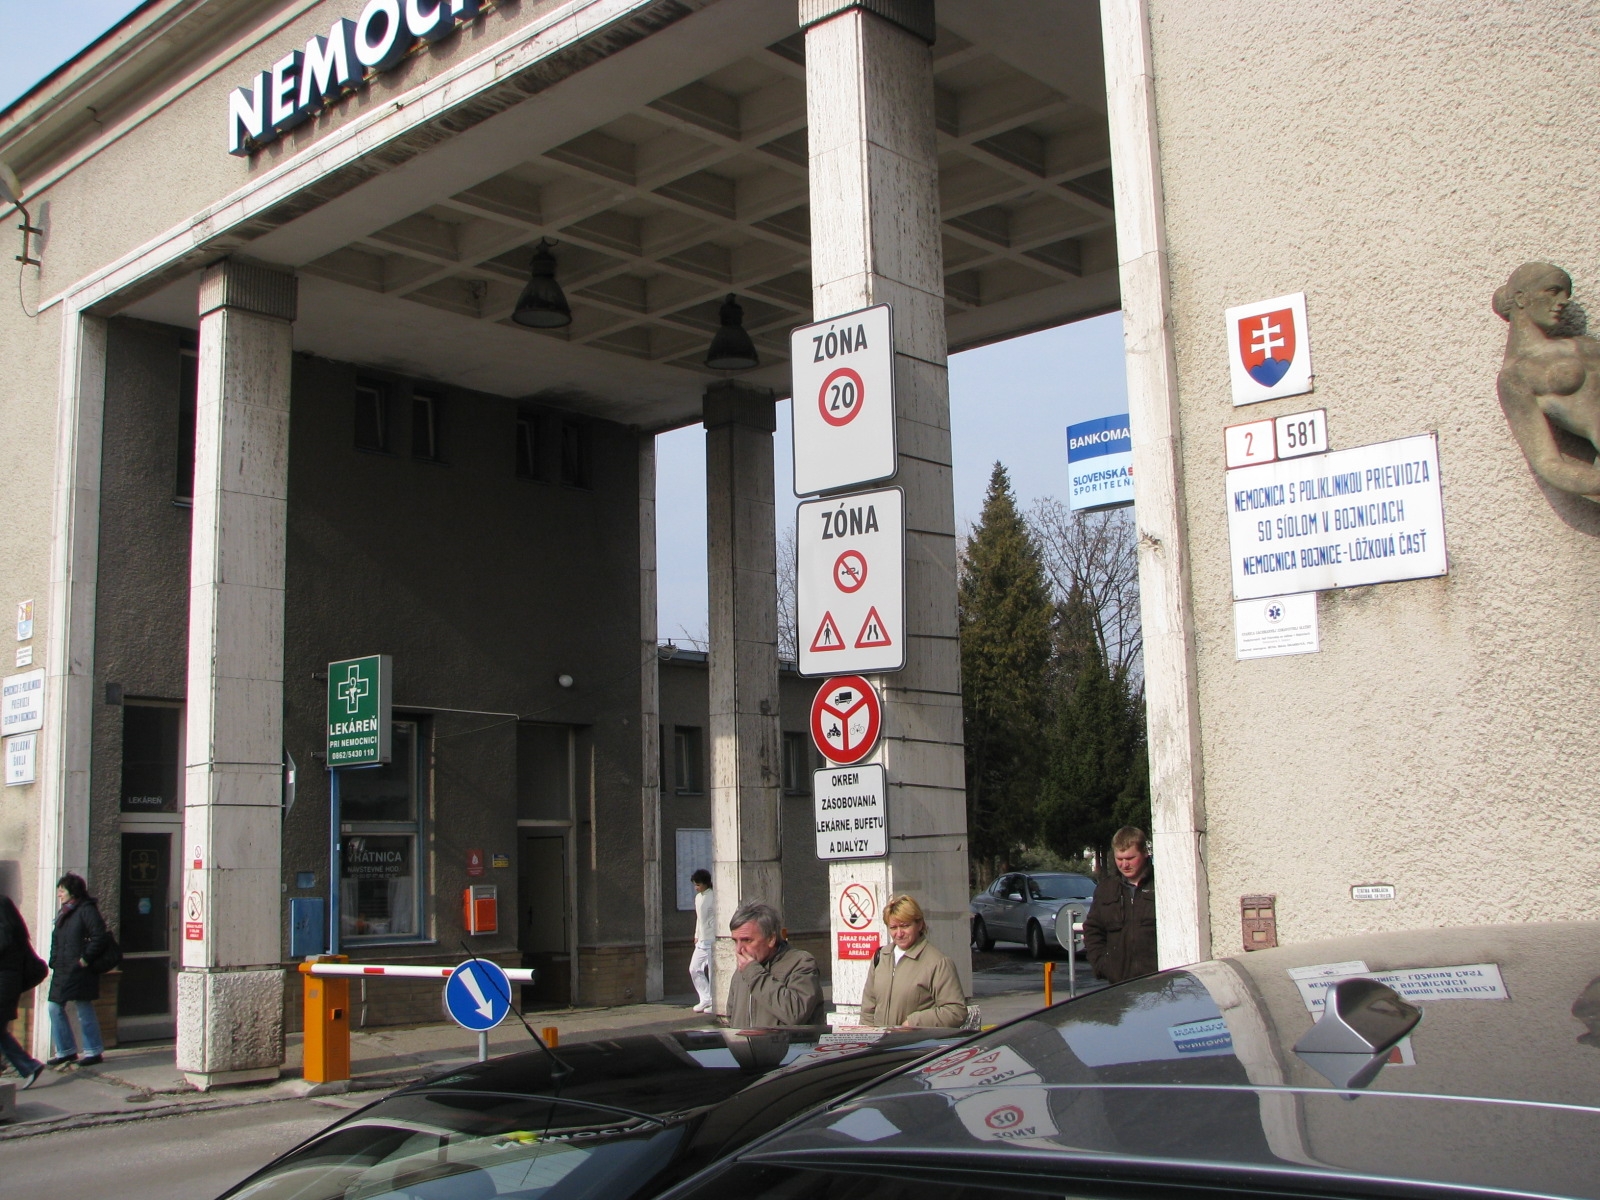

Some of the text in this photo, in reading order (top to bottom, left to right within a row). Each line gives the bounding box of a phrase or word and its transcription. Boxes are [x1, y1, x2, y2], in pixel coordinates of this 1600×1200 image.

[228, 0, 465, 155] NEMOC
[812, 324, 868, 364] ZÓNA
[830, 382, 855, 411] 20
[1069, 427, 1130, 450] BANKOMA
[1244, 432, 1254, 457] 2
[1286, 419, 1316, 449] 581
[1073, 465, 1128, 487] SLOVENSKÁ
[1073, 476, 1134, 496] SPORITEĽŇ
[1234, 460, 1430, 512] NEMOCNICA S POLIKLINIKOU PRIEVIDZA
[821, 502, 879, 540] ZÓNA
[1257, 499, 1405, 542] SO SÍDLOM V BOJNICIACH
[1243, 550, 1297, 576] NEMOCNICA
[1398, 528, 1427, 555] ČASŤ
[329, 715, 377, 736] LEKÁREŇ
[329, 736, 377, 749] PRI NEMOCNICI
[331, 748, 374, 760] 0862/5430 110
[831, 773, 859, 787] OKREM
[822, 795, 876, 810] ZÁSOBOVANIA
[817, 816, 883, 832] LEKÁRNE, BUFETU
[830, 837, 869, 853] A DIALÝZY
